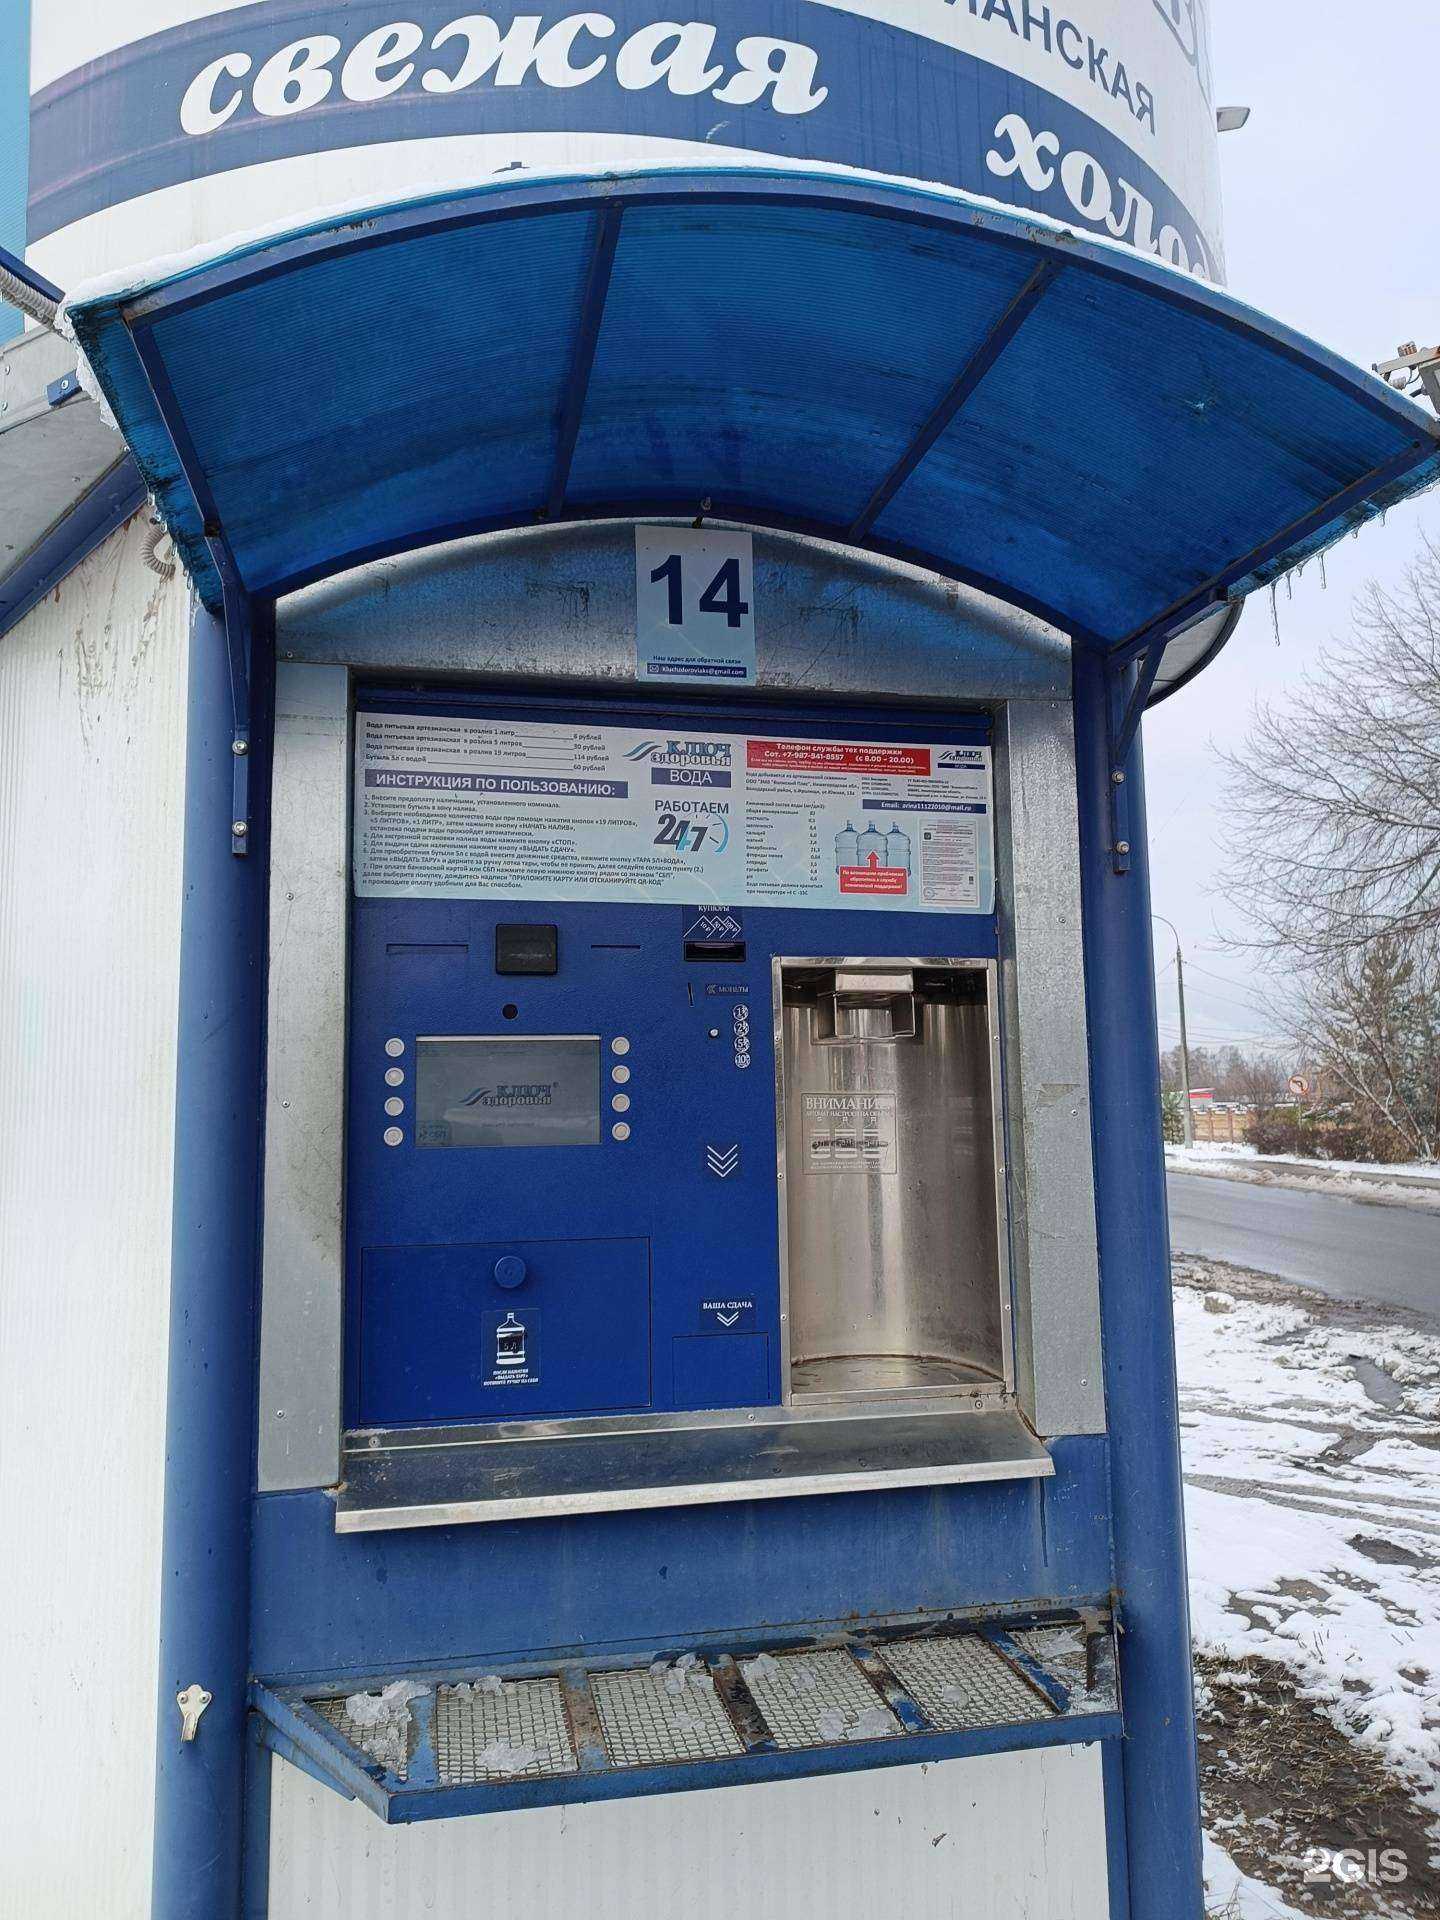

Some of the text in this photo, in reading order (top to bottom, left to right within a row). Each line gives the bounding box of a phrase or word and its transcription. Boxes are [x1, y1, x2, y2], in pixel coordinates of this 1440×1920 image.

[180, 13, 827, 135] свежая
[986, 114, 1210, 280] холо
[651, 554, 748, 627] 14
[666, 740, 731, 756] КЛЮЧ
[776, 743, 902, 756] Телефон службы тех поддержки
[651, 752, 731, 766] здоровья
[889, 756, 914, 764] 20.00)
[376, 773, 472, 789] ИНСТРУКЦИЯ
[500, 778, 616, 794] ПОЛЬЗОВАНИЮ:
[670, 769, 713, 784] ВОДА
[654, 799, 729, 814] РАБОТАЕМ
[496, 1085, 552, 1097] КЛЮЧ
[482, 1095, 552, 1108] здоровья
[702, 1300, 753, 1310] ВАША СДАЧА
